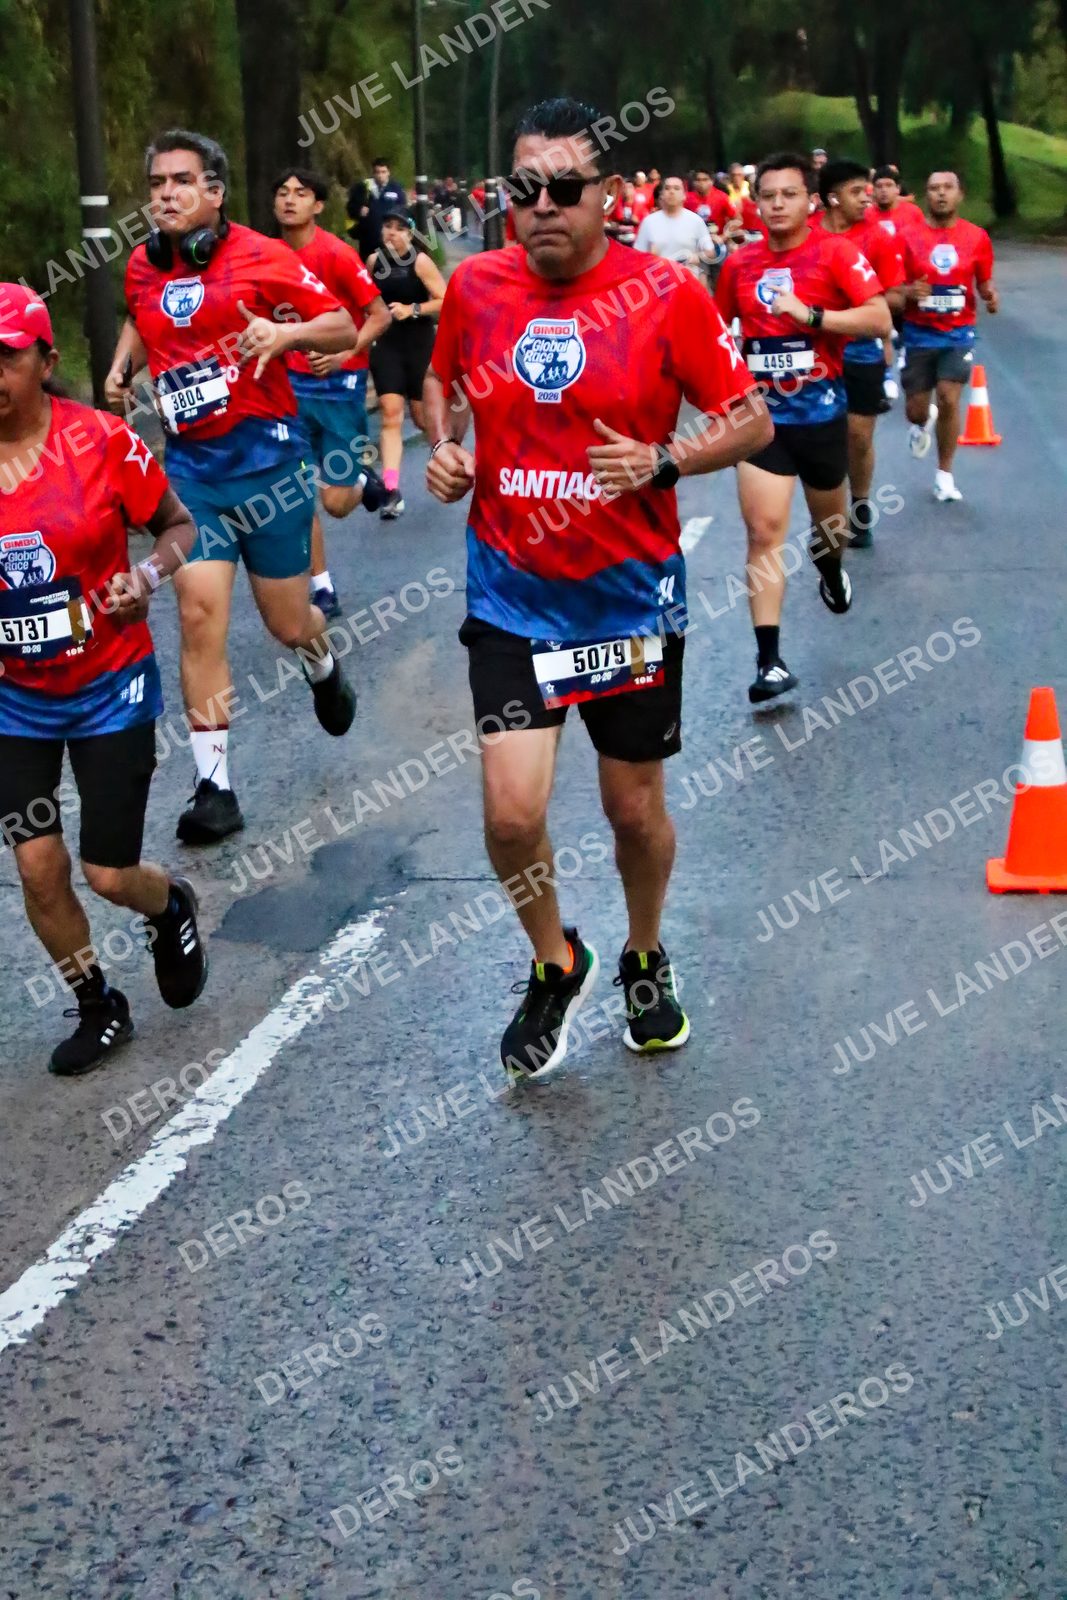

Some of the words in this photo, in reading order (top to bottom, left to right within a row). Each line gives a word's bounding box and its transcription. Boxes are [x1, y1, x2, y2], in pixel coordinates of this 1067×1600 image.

[533, 326, 570, 335] BIMBO
[531, 339, 569, 352] Global
[524, 350, 554, 362] Race
[763, 354, 793, 369] 4459
[170, 387, 205, 411] 3804
[3, 538, 37, 549] BIMBO
[7, 549, 39, 562] Global
[4, 560, 29, 571] Race
[1, 616, 49, 642] 5737
[65, 646, 84, 657] 10K
[573, 642, 626, 673] 5079
[634, 675, 653, 685] 10K
